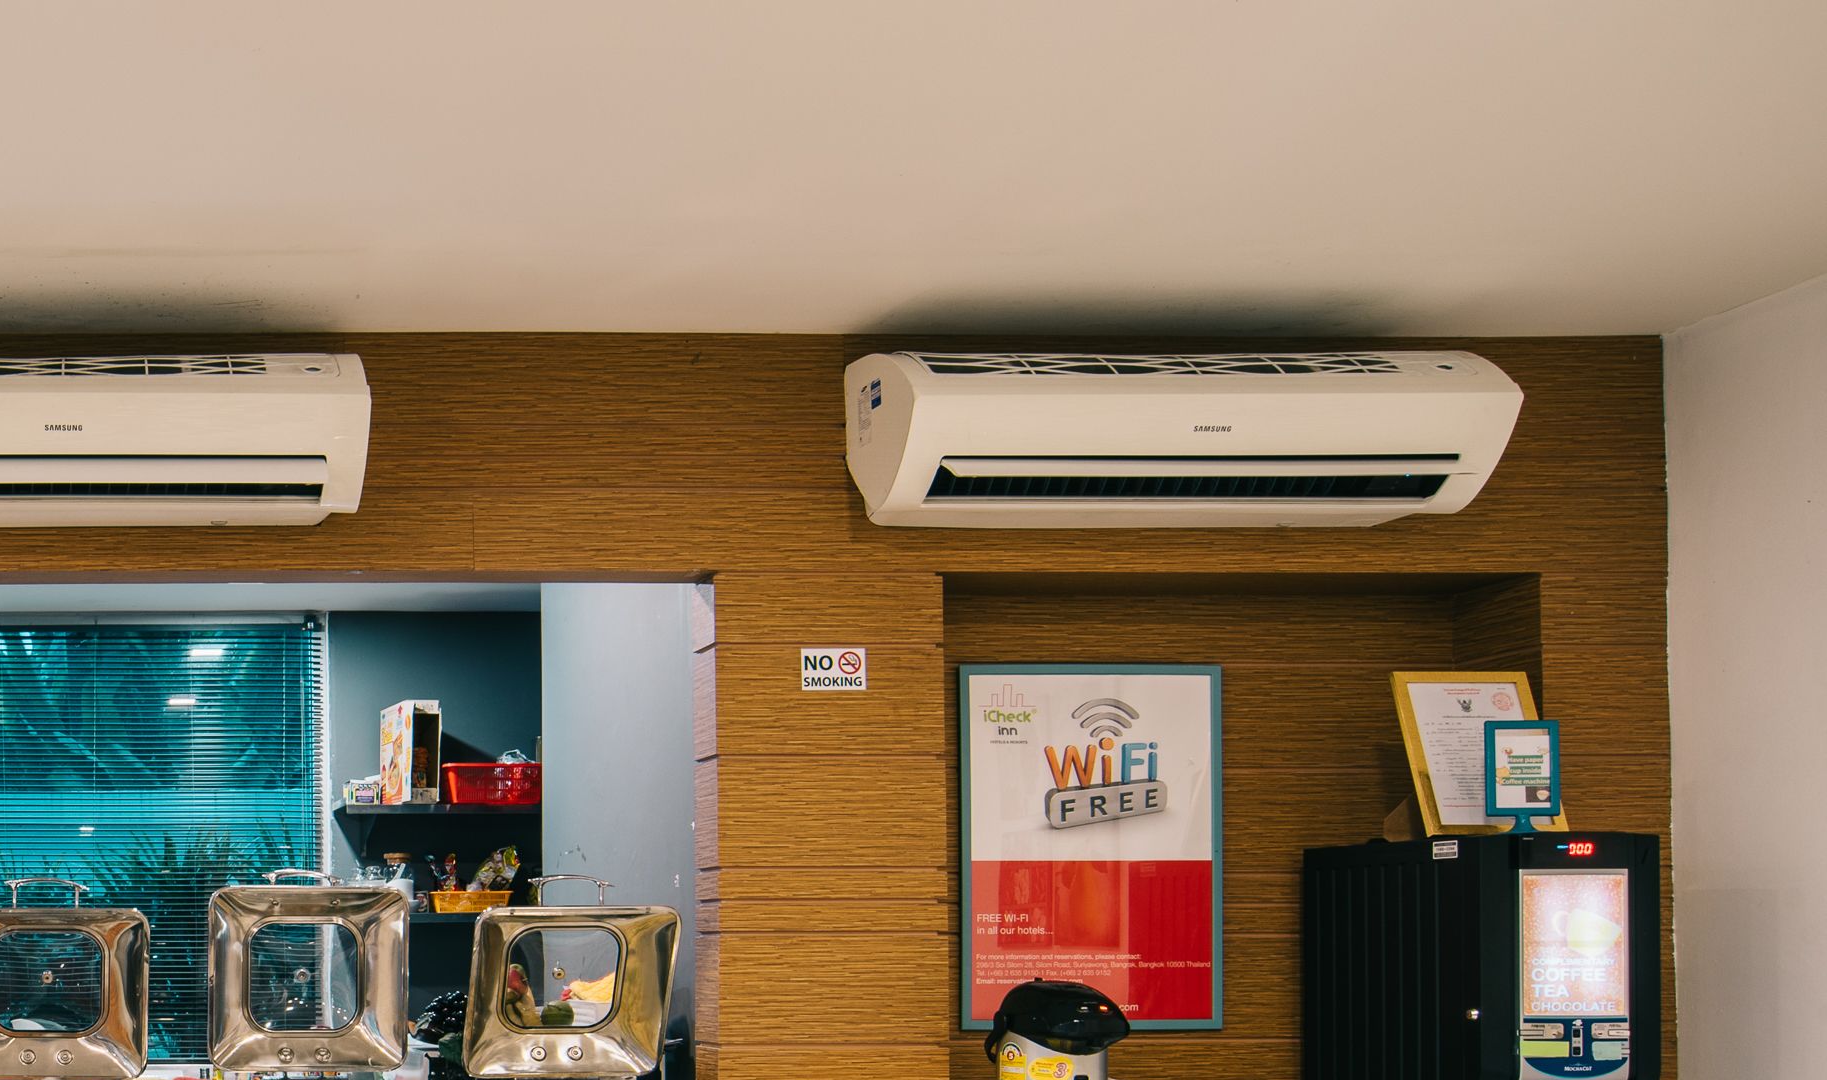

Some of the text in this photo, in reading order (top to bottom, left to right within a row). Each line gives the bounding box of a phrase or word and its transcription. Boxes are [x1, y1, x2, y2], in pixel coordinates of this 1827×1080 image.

[44, 424, 83, 432] SAMSUNG
[1193, 425, 1232, 433] SAMSUNG
[804, 655, 833, 671] NO
[803, 676, 863, 688] SMOKING
[983, 709, 1032, 723] iCheck
[998, 725, 1018, 736] inn
[1044, 737, 1158, 791] WiFi
[1060, 788, 1158, 822] FREE
[976, 913, 1029, 923] FREE WI-FI
[976, 926, 985, 935] in
[987, 925, 998, 935] all
[1000, 927, 1015, 935] our
[1138, 961, 1164, 969] Bangkok
[1531, 967, 1607, 981] COFFEE
[1531, 984, 1570, 998] TEA
[1531, 1001, 1616, 1012] CHOCOLATE
[1053, 1062, 1068, 1079] 3
